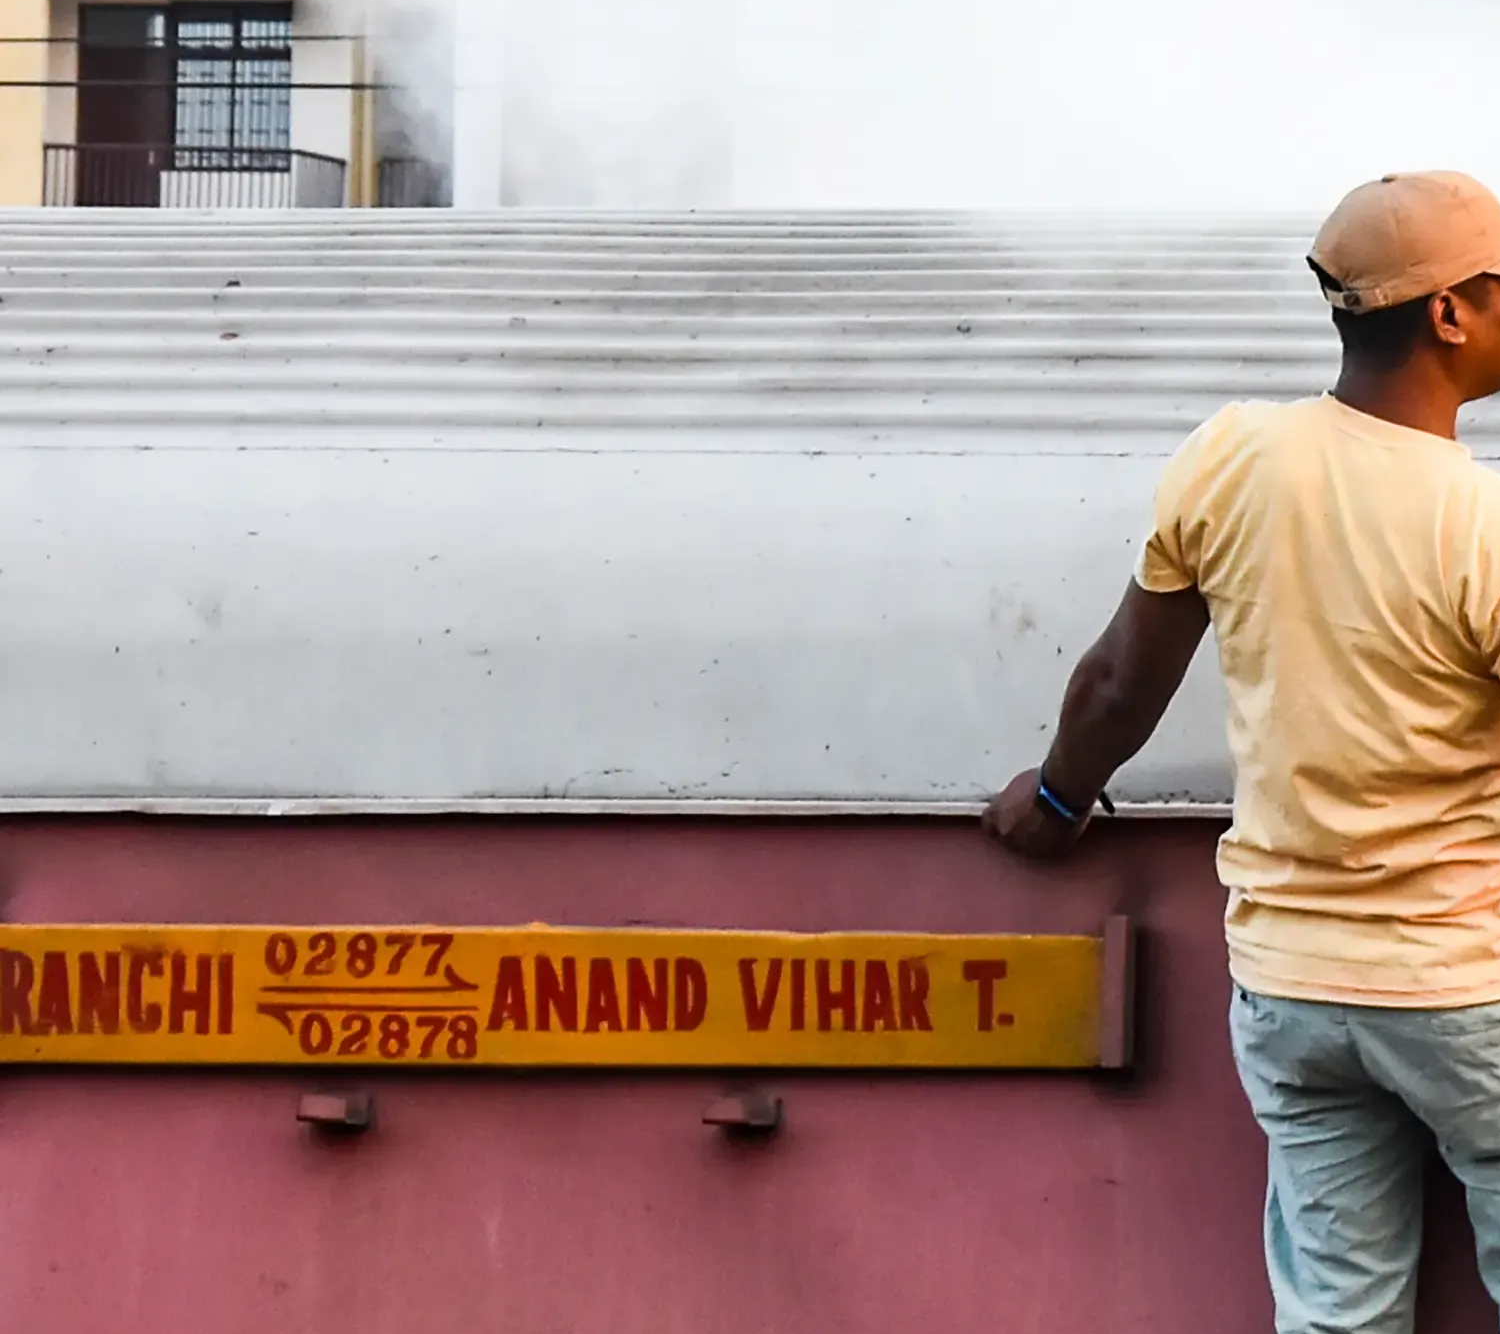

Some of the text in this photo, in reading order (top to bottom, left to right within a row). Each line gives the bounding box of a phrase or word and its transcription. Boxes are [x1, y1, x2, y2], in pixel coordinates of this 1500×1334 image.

[265, 932, 455, 980] 02877
[0, 947, 1015, 1036] RANCHI ANAND VIHAR T.
[300, 1012, 478, 1060] 02878
